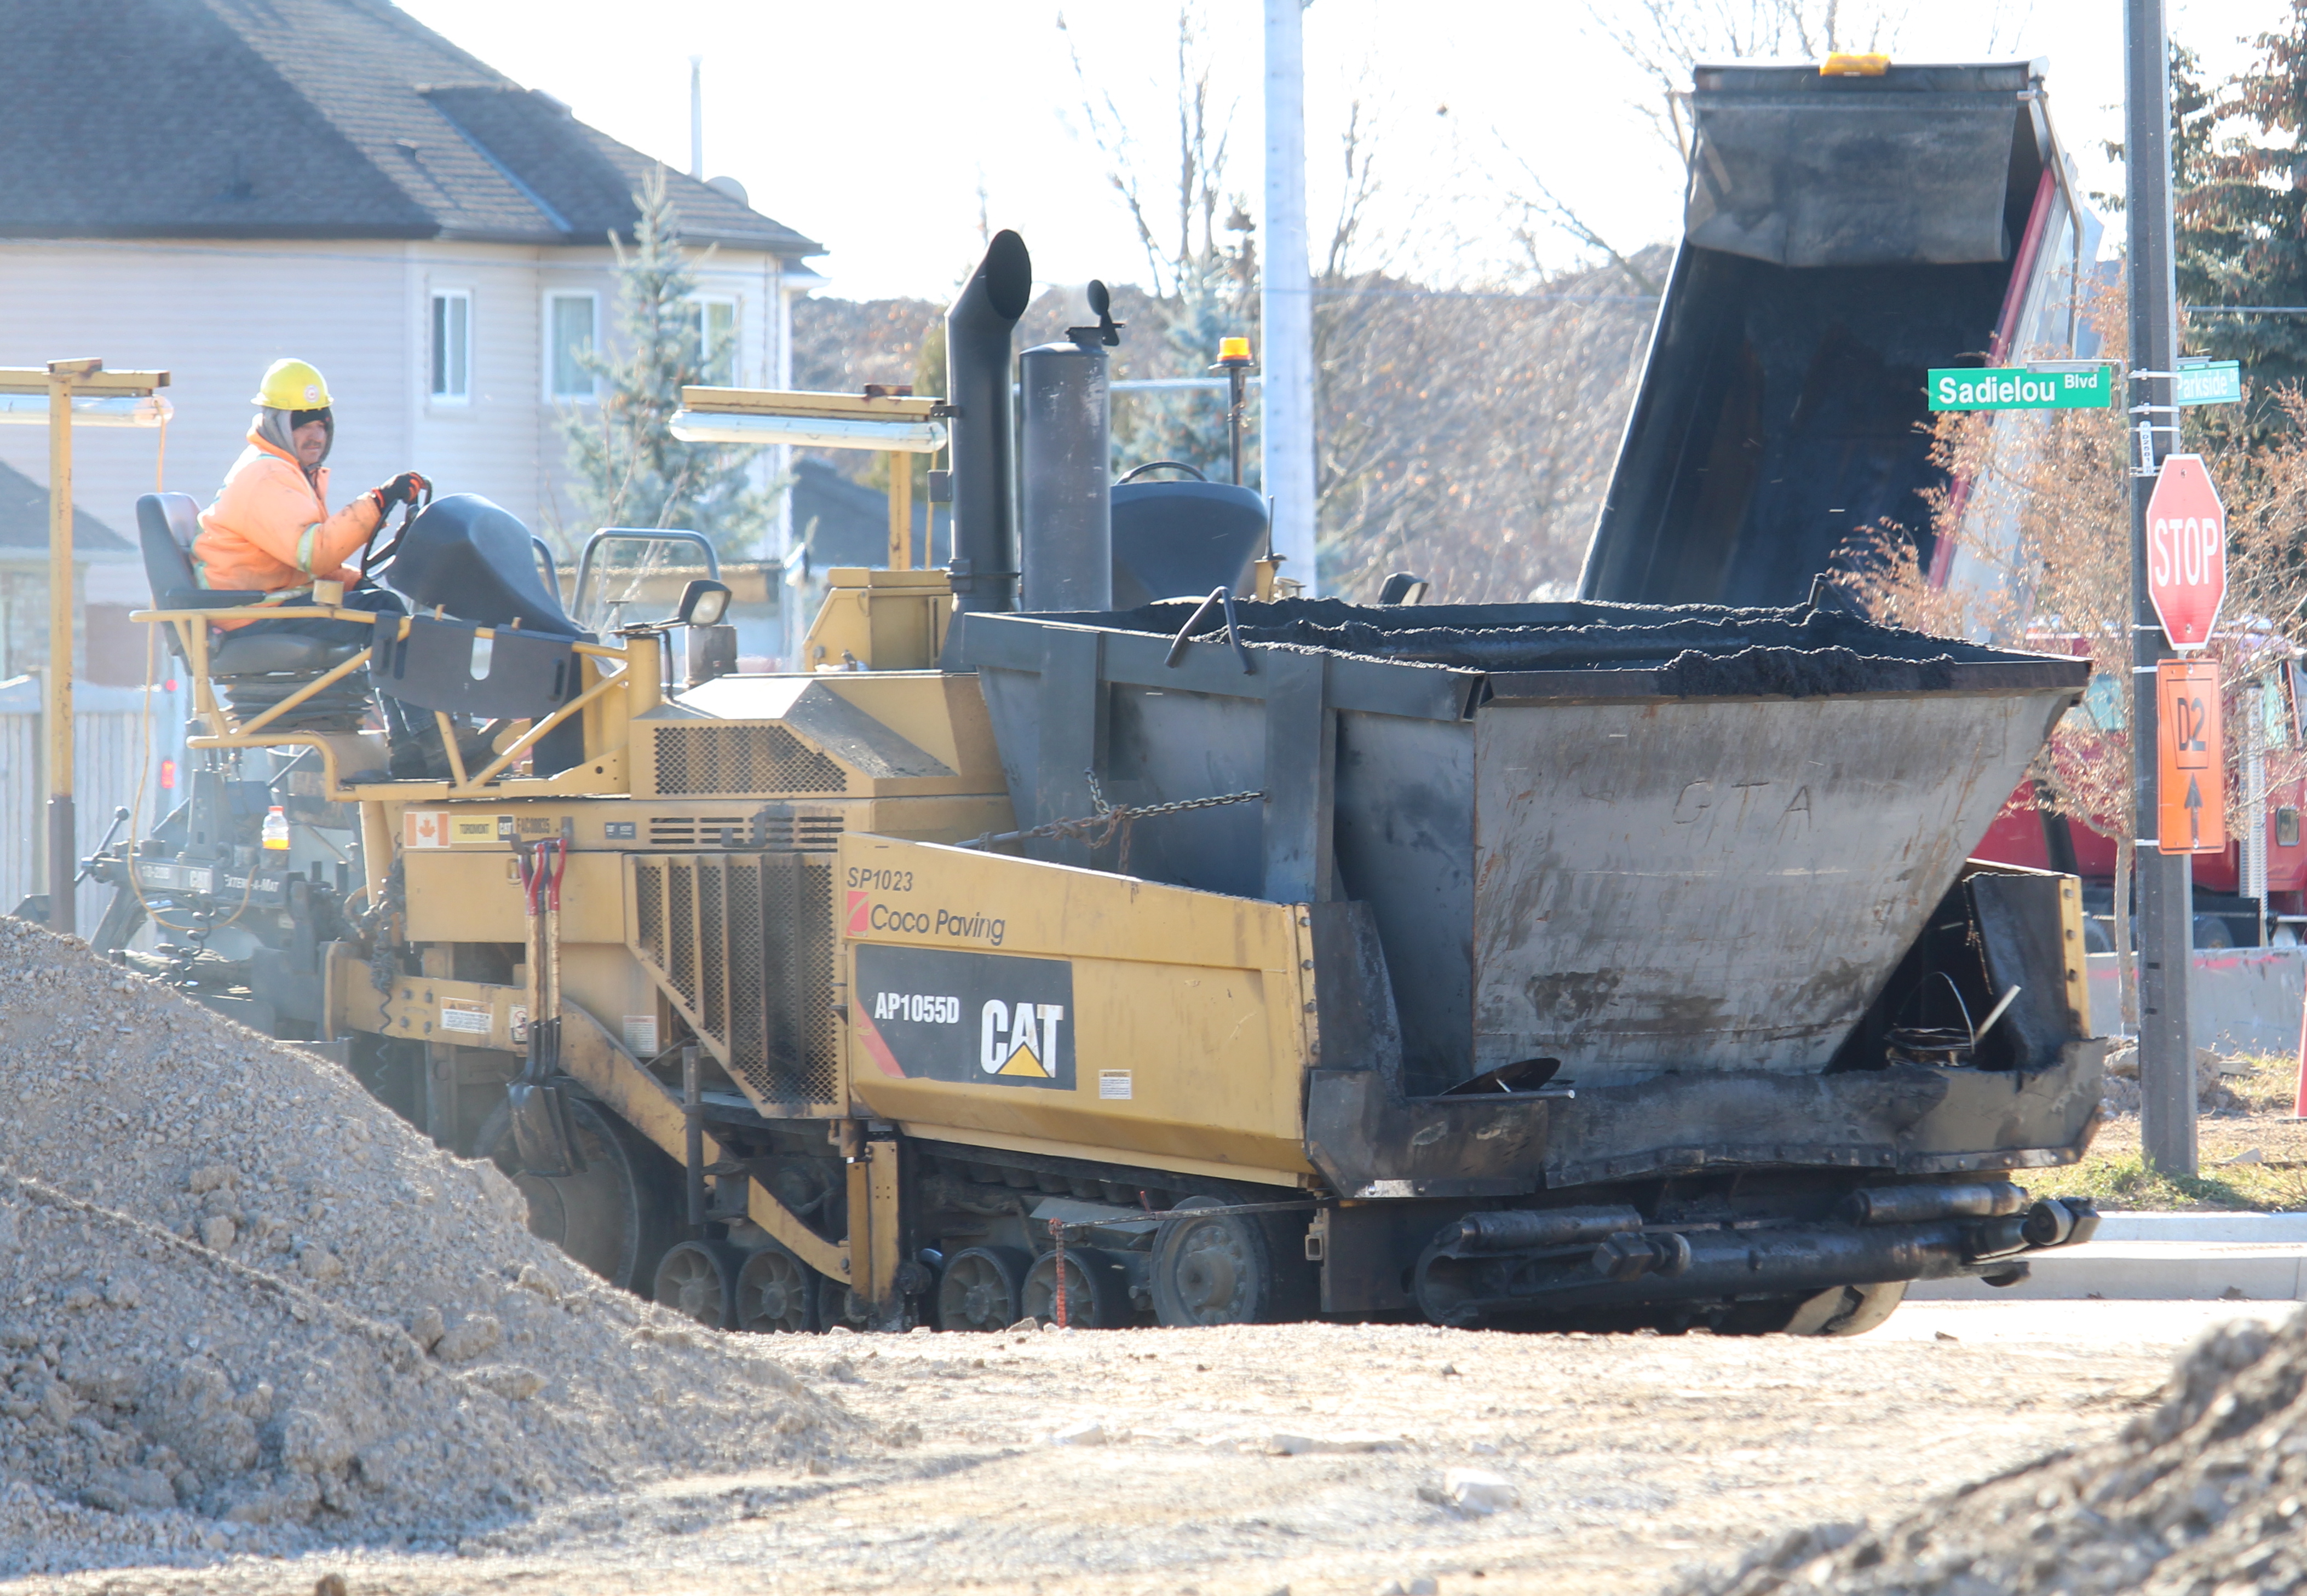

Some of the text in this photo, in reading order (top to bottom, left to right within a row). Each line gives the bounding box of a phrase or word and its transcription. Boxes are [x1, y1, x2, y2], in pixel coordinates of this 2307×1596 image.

[1939, 374, 2098, 404] Sadielou Blvd
[2154, 517, 2218, 587] STOP
[2178, 697, 2206, 751] D2
[1672, 779, 1811, 832] GTA
[847, 867, 913, 891] SP1023
[871, 904, 1005, 946] Coco Paving
[874, 992, 959, 1024] AP1055D
[980, 999, 1064, 1079] CAT
